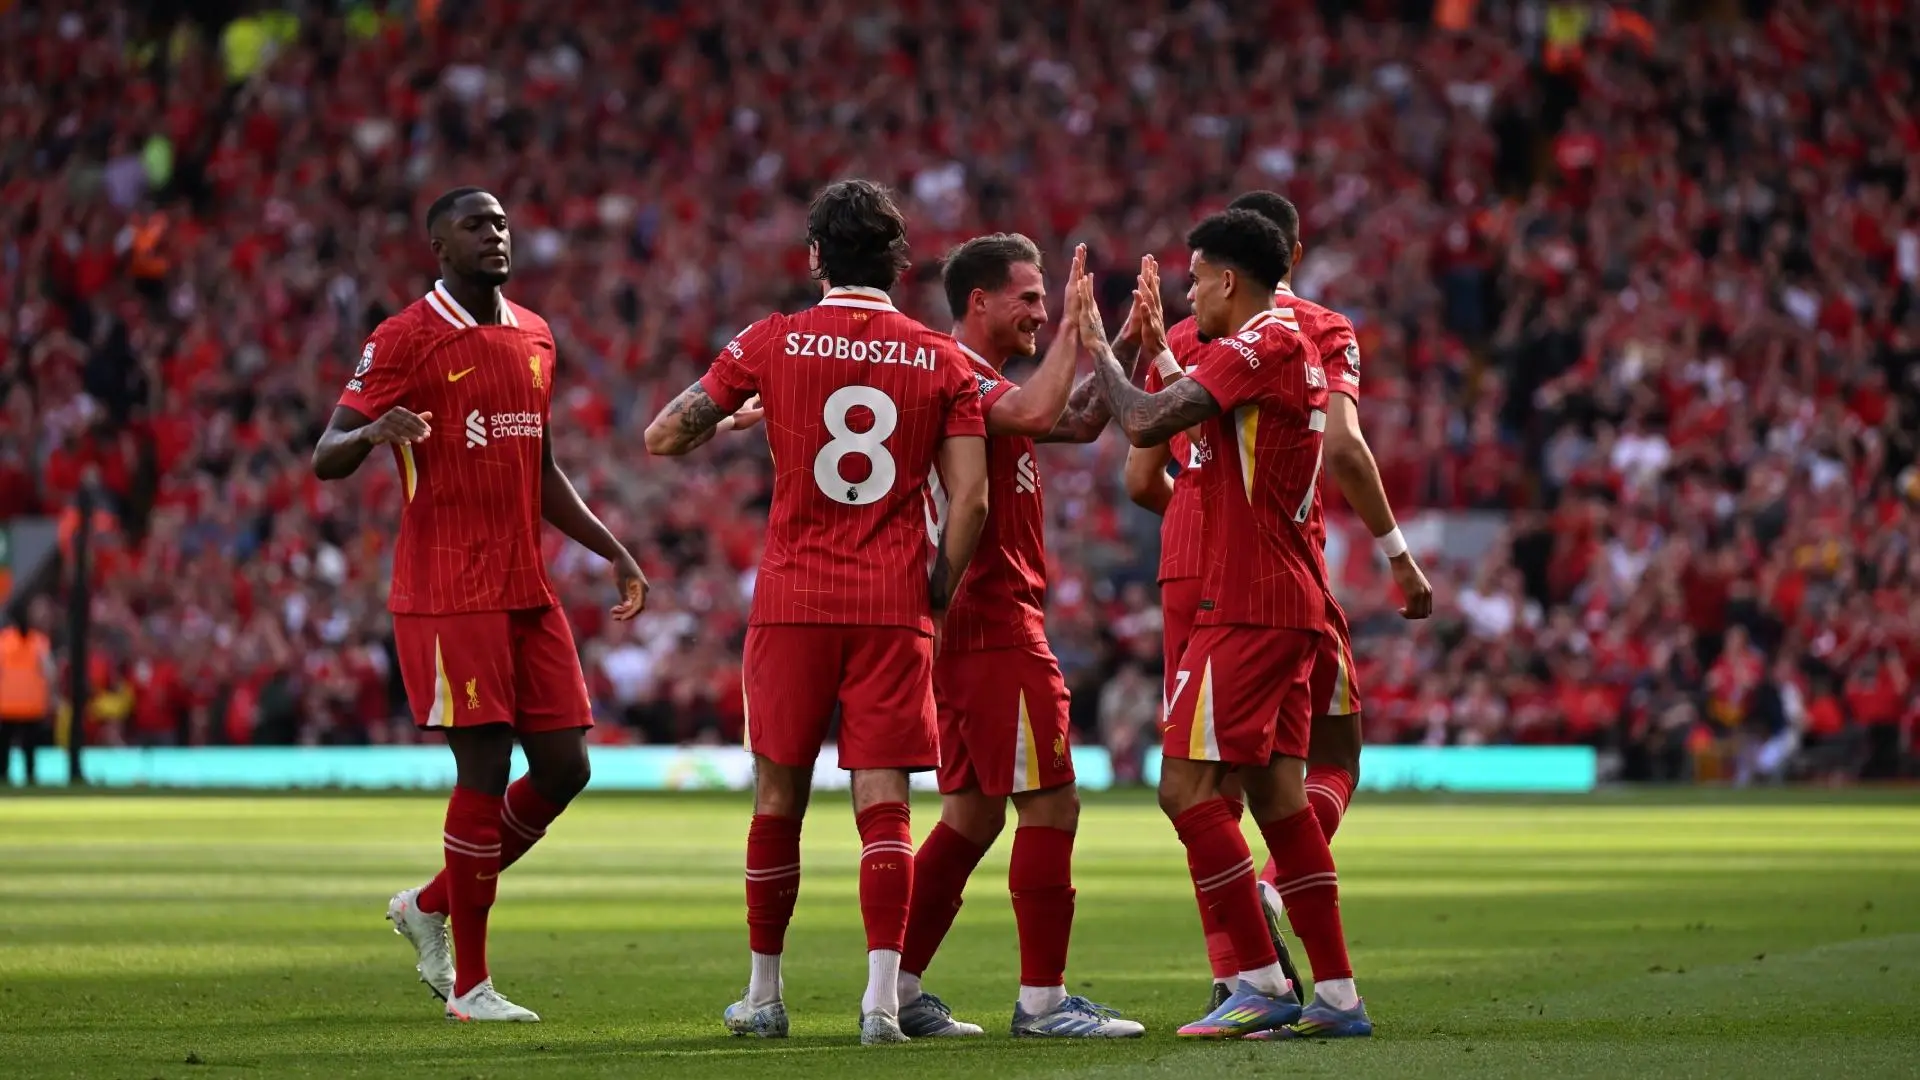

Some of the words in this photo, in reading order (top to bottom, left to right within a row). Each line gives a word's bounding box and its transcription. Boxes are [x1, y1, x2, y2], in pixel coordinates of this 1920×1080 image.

[785, 332, 936, 371] SZOBOSZLAI
[814, 385, 898, 505] 8
[1168, 670, 1191, 715] 7
